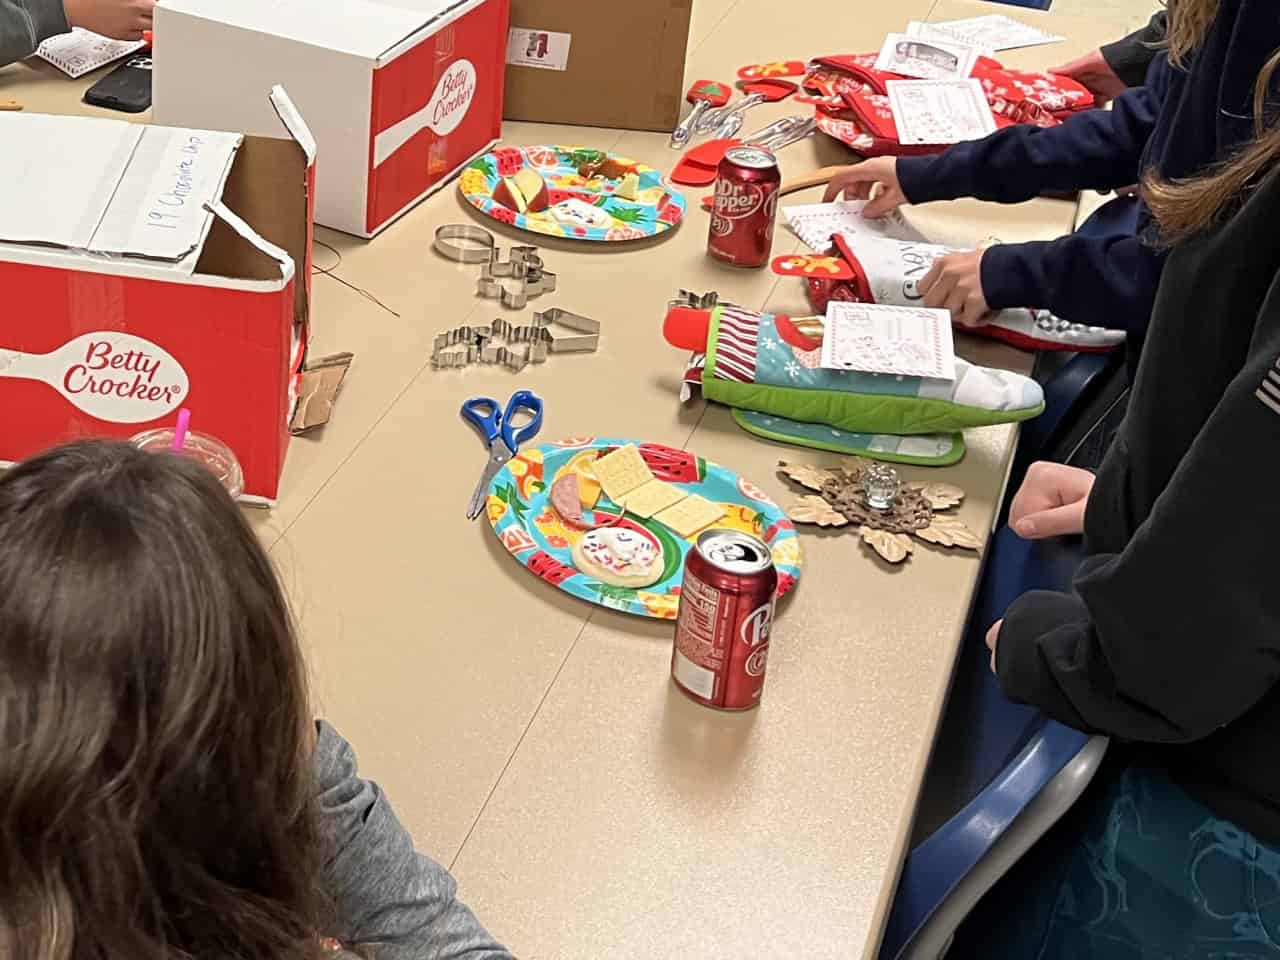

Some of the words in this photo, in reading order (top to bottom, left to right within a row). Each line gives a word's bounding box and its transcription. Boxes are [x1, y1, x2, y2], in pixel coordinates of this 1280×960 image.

[441, 69, 468, 100] Betty
[716, 179, 743, 196] Dr
[85, 341, 162, 377] Betty
